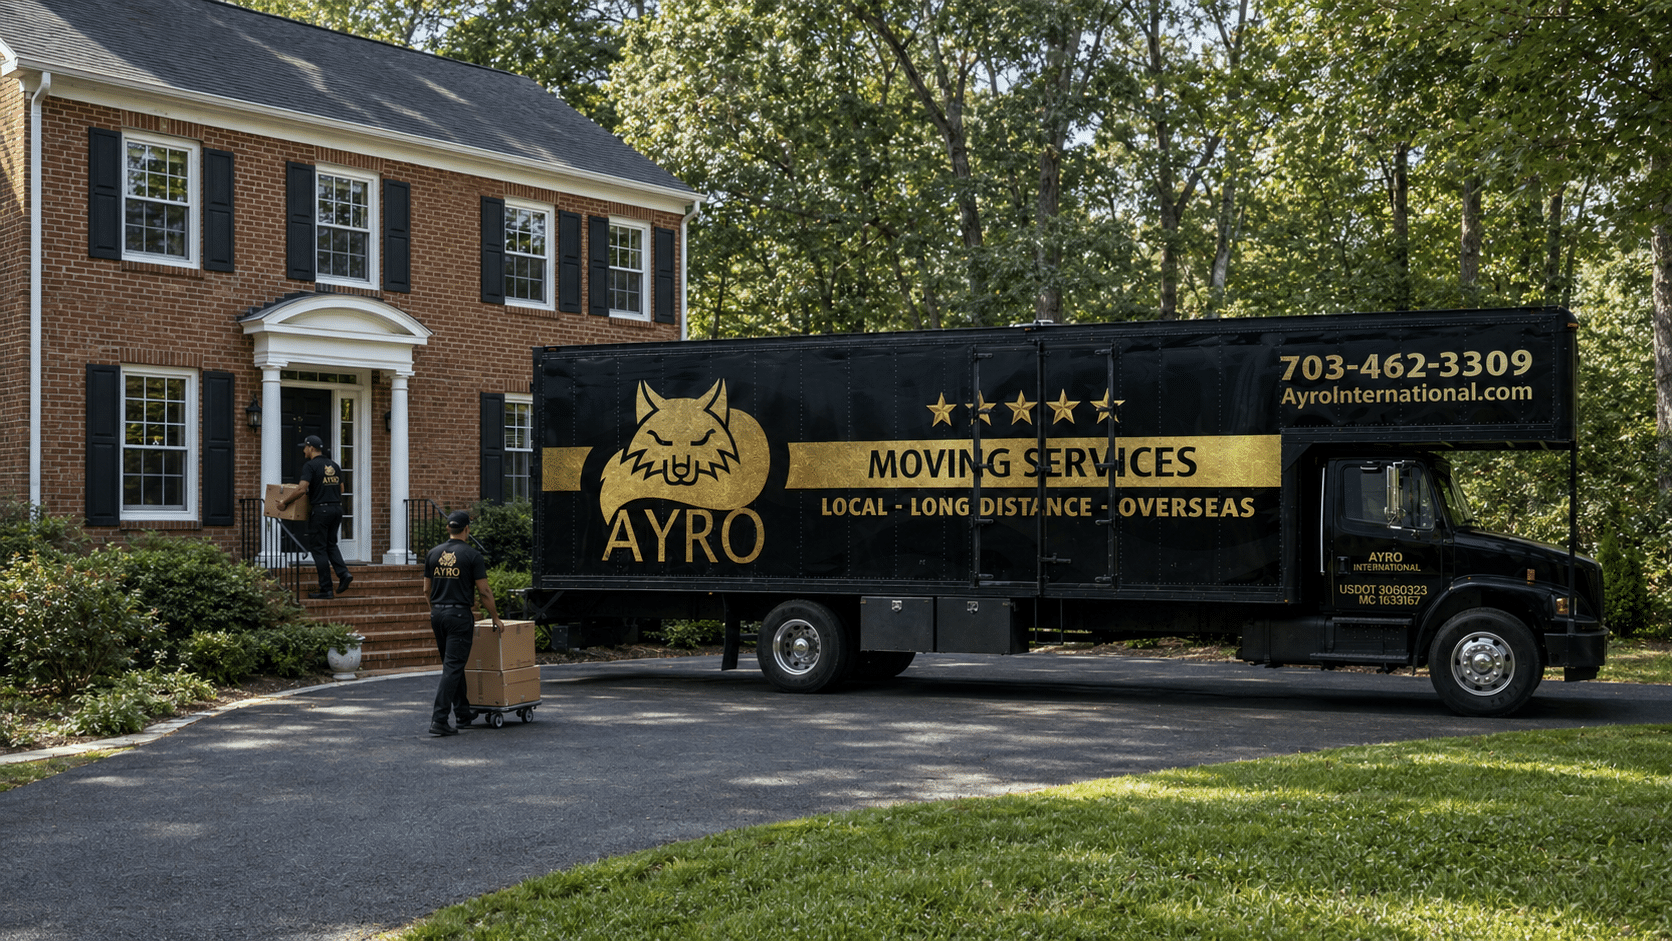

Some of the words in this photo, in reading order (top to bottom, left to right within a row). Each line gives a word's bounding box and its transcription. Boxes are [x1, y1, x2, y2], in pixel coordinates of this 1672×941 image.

[1280, 349, 1533, 381] 703-462-3309
[1281, 382, 1533, 409] AyroInternational.com
[868, 448, 1011, 479] MOVING
[1023, 446, 1198, 478] SERVICES
[821, 497, 888, 516] LOCAL
[910, 497, 970, 517] LONG
[979, 497, 1092, 517] DISTANCE
[1118, 497, 1255, 518] OVERSEAS
[601, 507, 765, 564] AYRO
[1368, 551, 1403, 563] AYRO
[433, 566, 460, 577] AYRO
[1353, 563, 1421, 572] INTERNATIONAL
[1339, 584, 1377, 595] USDOT
[1378, 584, 1428, 596] 3060323
[1358, 595, 1376, 605] MC
[1378, 595, 1421, 606] 1633167
